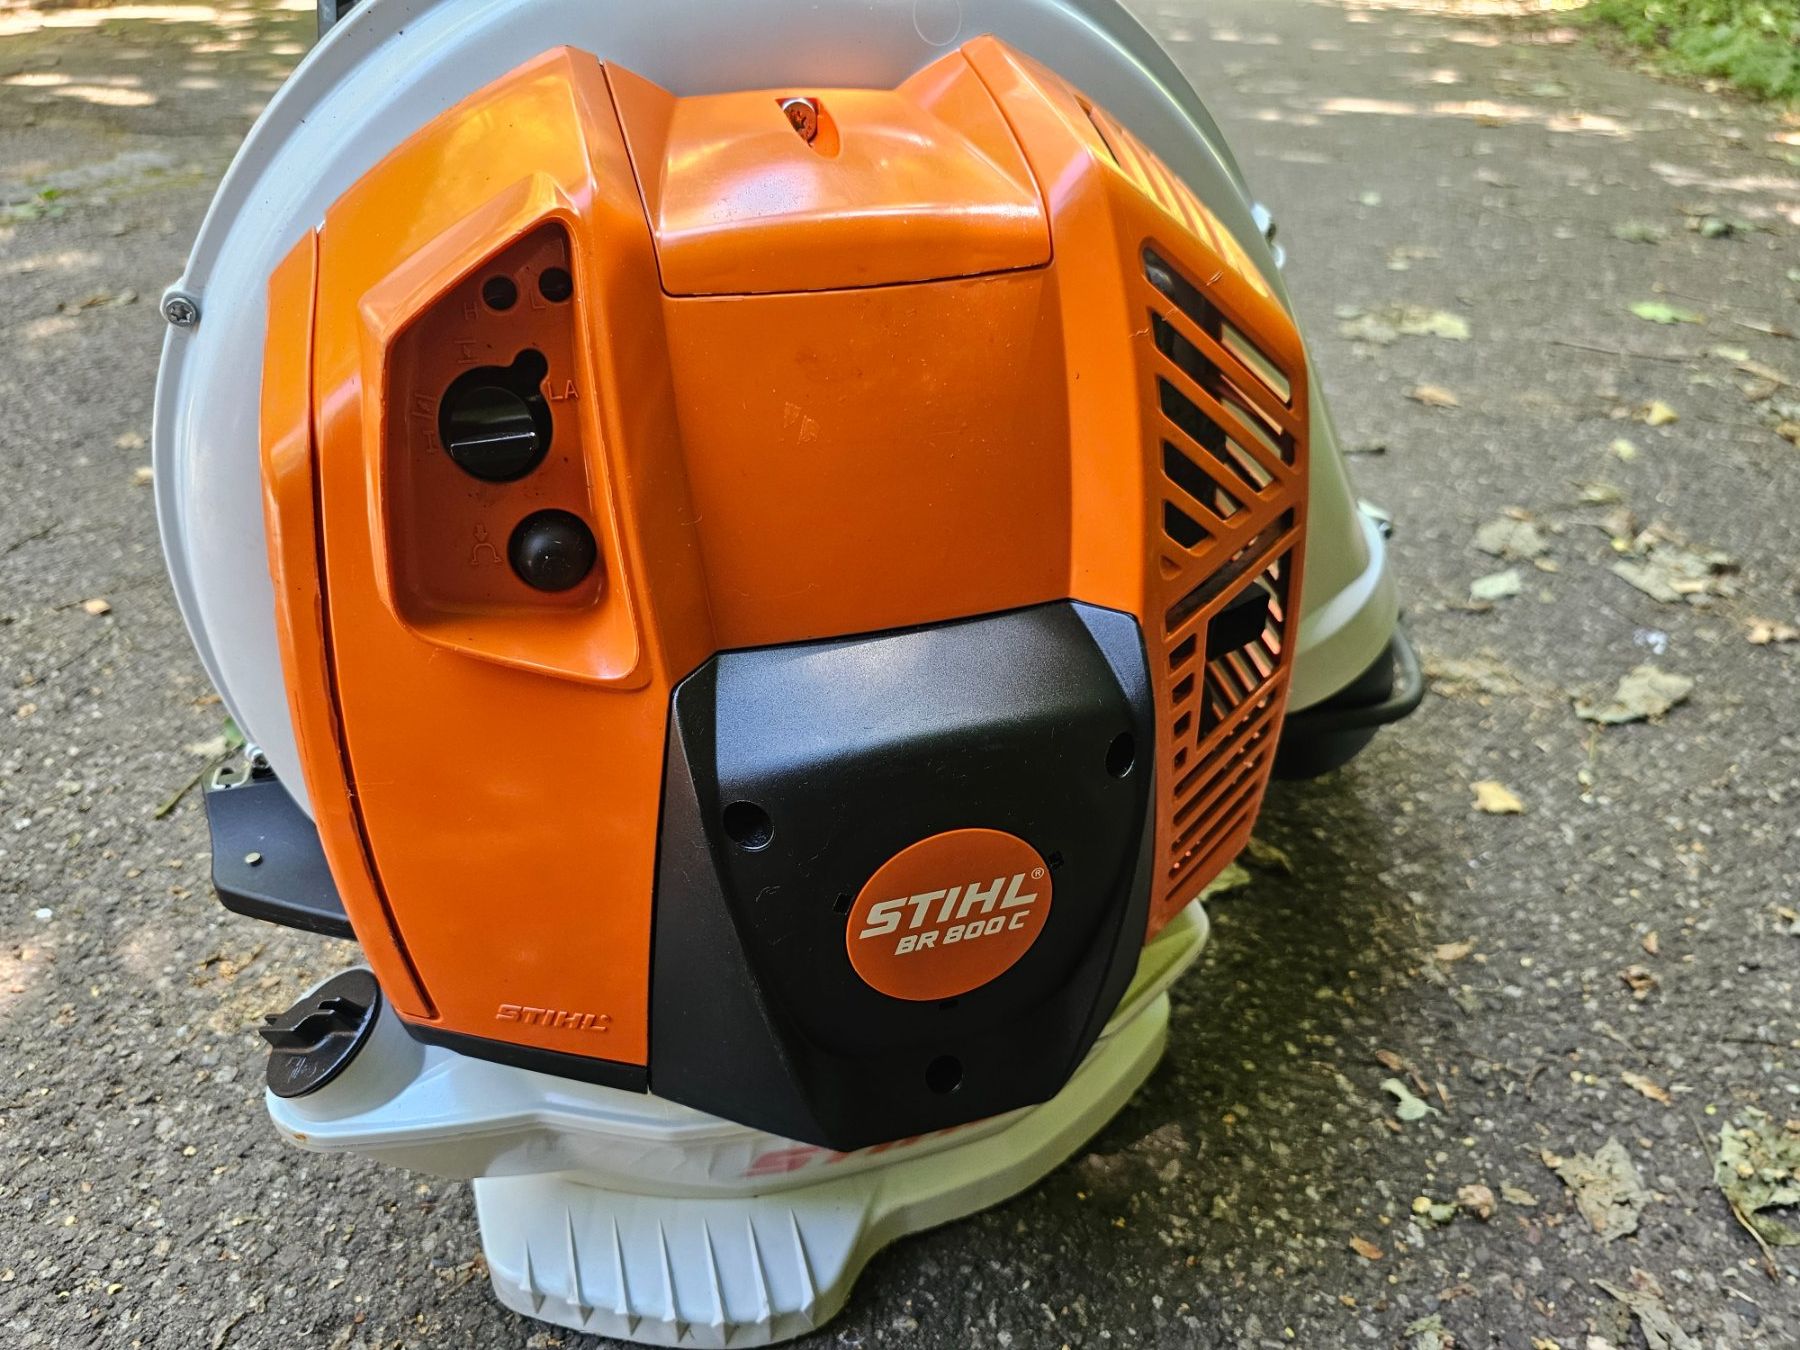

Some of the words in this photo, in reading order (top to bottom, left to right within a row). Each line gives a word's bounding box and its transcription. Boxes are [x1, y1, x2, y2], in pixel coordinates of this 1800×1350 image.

[547, 380, 579, 400] LA
[894, 930, 939, 956] BR
[942, 915, 1006, 944] 800
[1008, 910, 1030, 930] C
